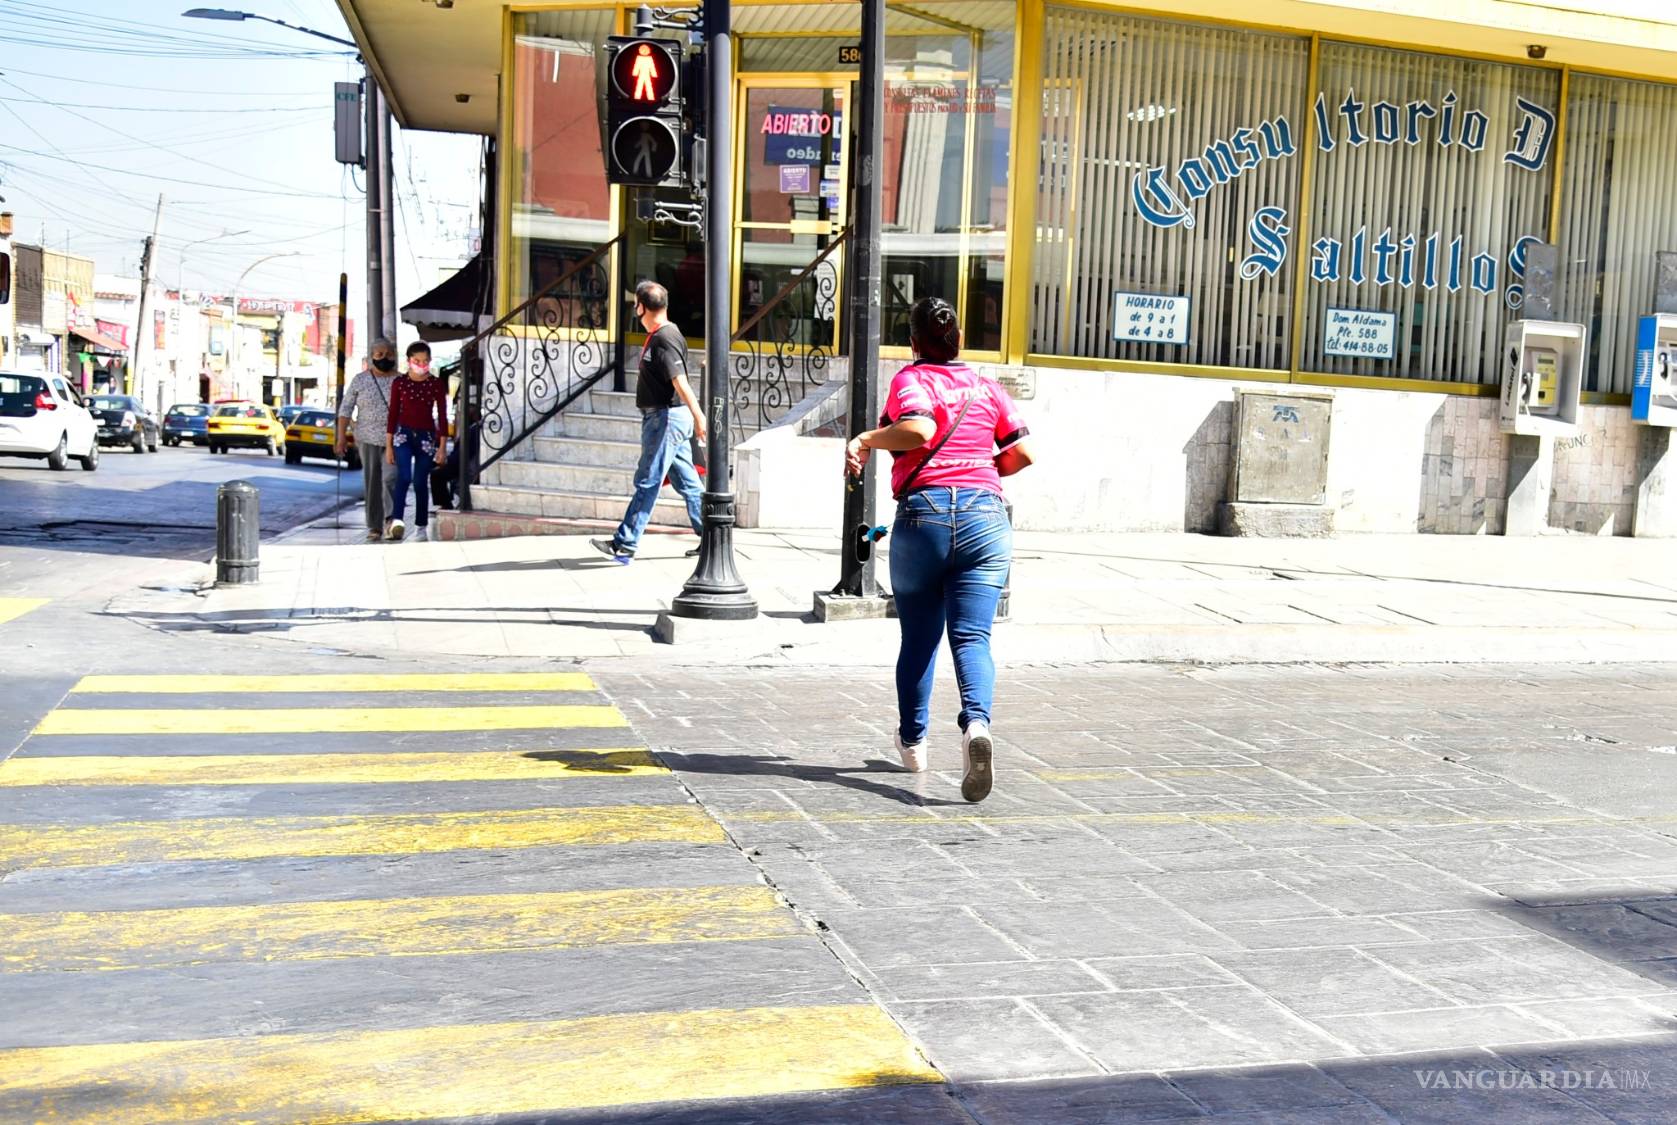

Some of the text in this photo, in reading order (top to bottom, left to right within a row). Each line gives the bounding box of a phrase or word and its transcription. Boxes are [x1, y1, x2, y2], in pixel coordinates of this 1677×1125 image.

[841, 48, 862, 62] 58
[760, 113, 831, 134] ABIERTO
[1126, 296, 1175, 311] HORARIO
[1129, 311, 1142, 322] de
[1148, 312, 1155, 323] 9
[1160, 315, 1166, 324] a
[1352, 314, 1388, 327] Aldama
[1128, 326, 1174, 339] de 4 a 8
[1358, 327, 1378, 340] 588
